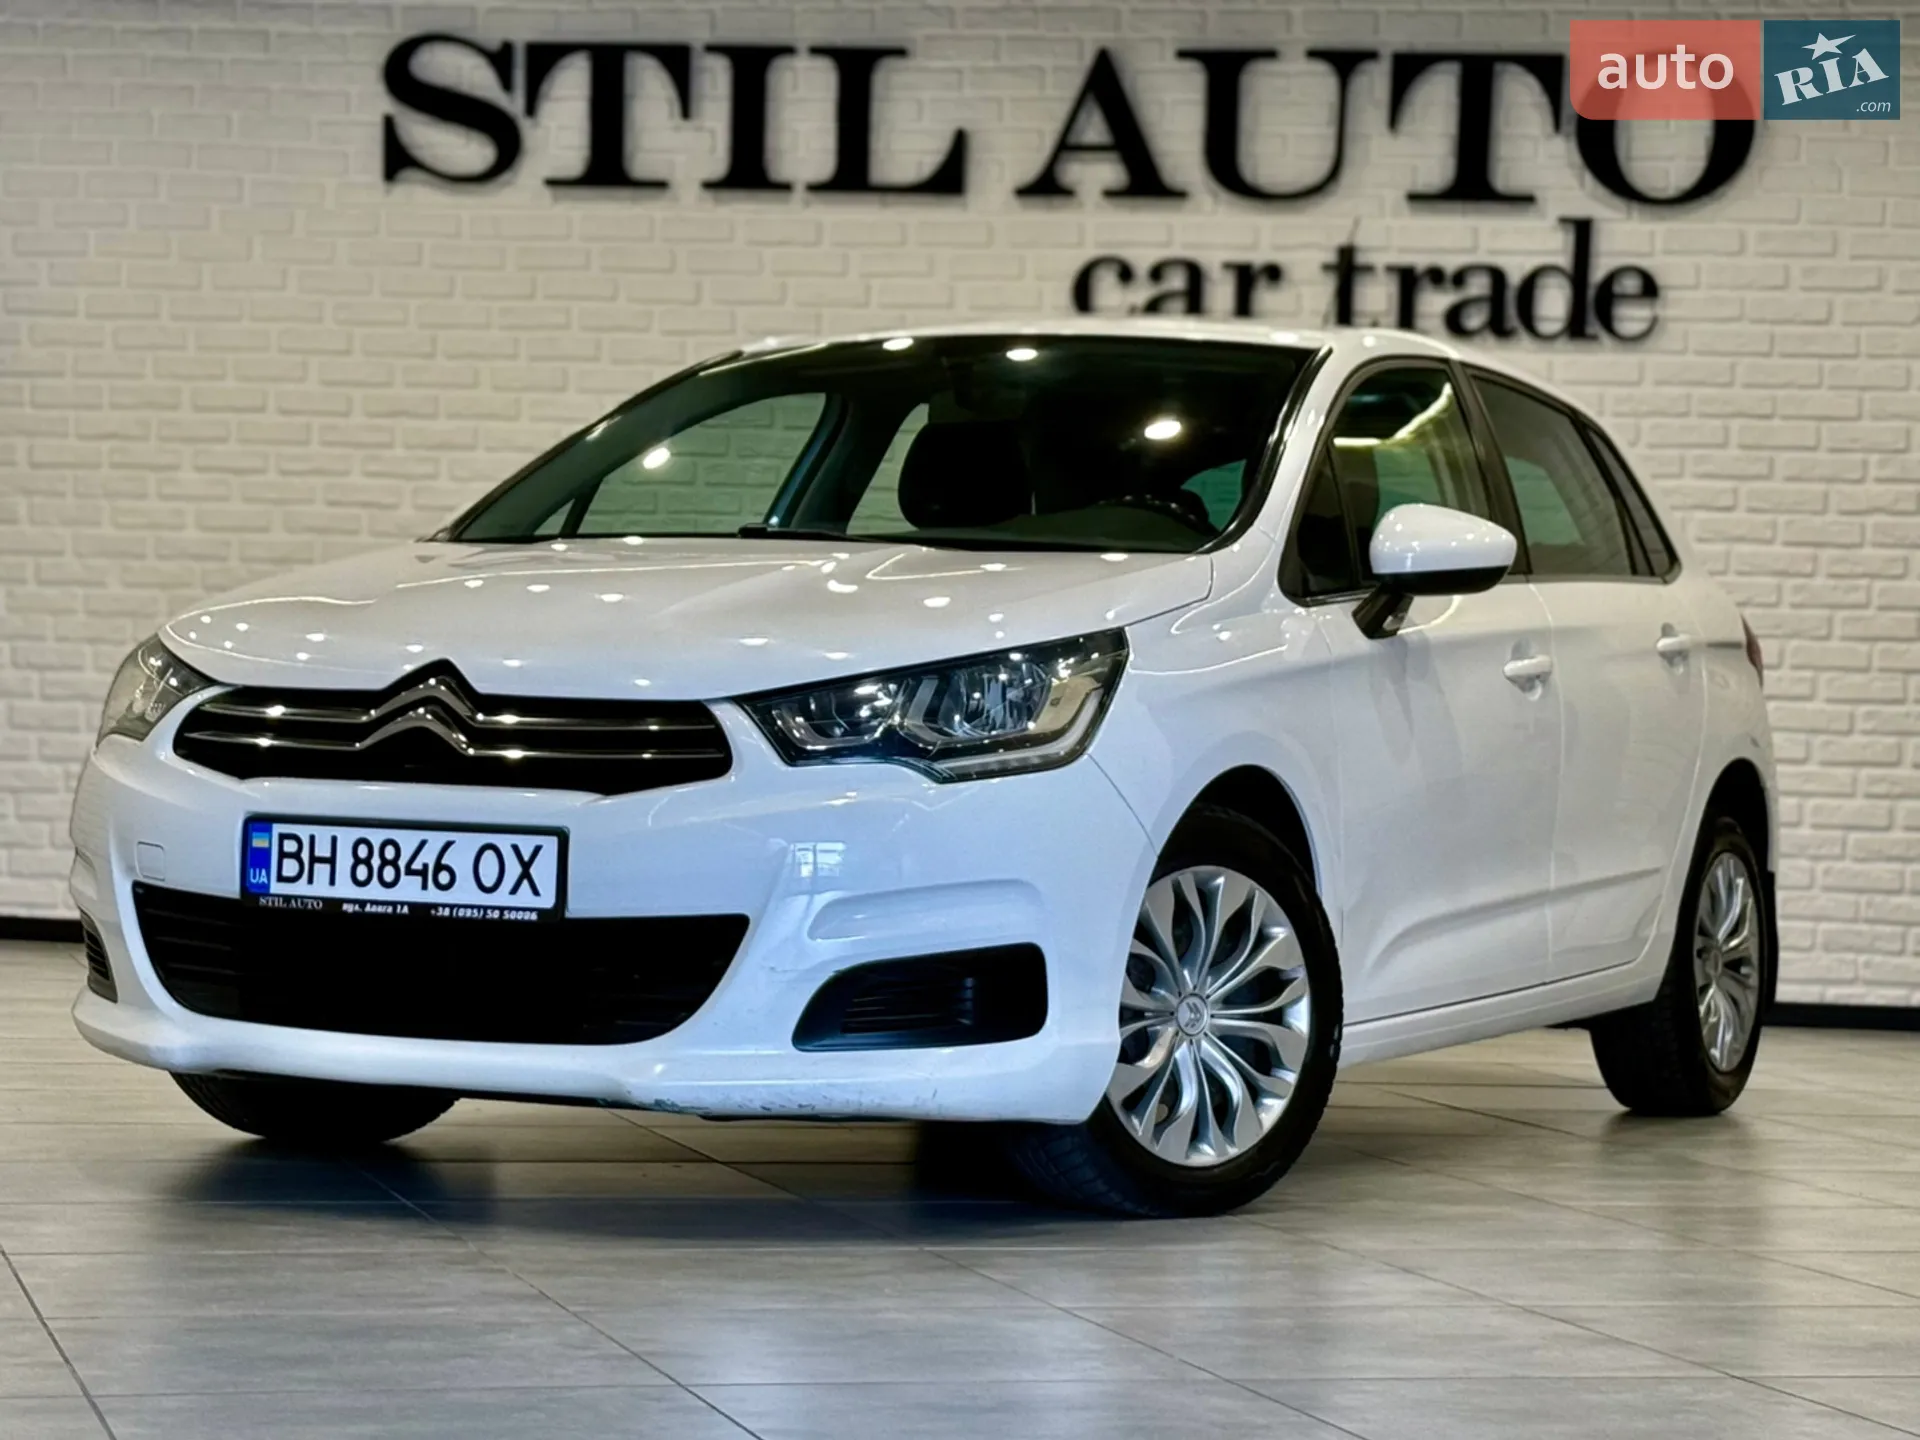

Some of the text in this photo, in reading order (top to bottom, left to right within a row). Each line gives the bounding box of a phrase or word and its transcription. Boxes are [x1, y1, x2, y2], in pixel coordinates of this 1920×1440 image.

[383, 33, 1757, 202] STIL AUTO
[1071, 216, 1661, 342] car trade
[249, 867, 269, 886] UA
[275, 832, 544, 897] BH 8846 OX
[259, 896, 323, 910] STIL AUTO
[429, 906, 450, 916] +38
[485, 909, 500, 919] 50
